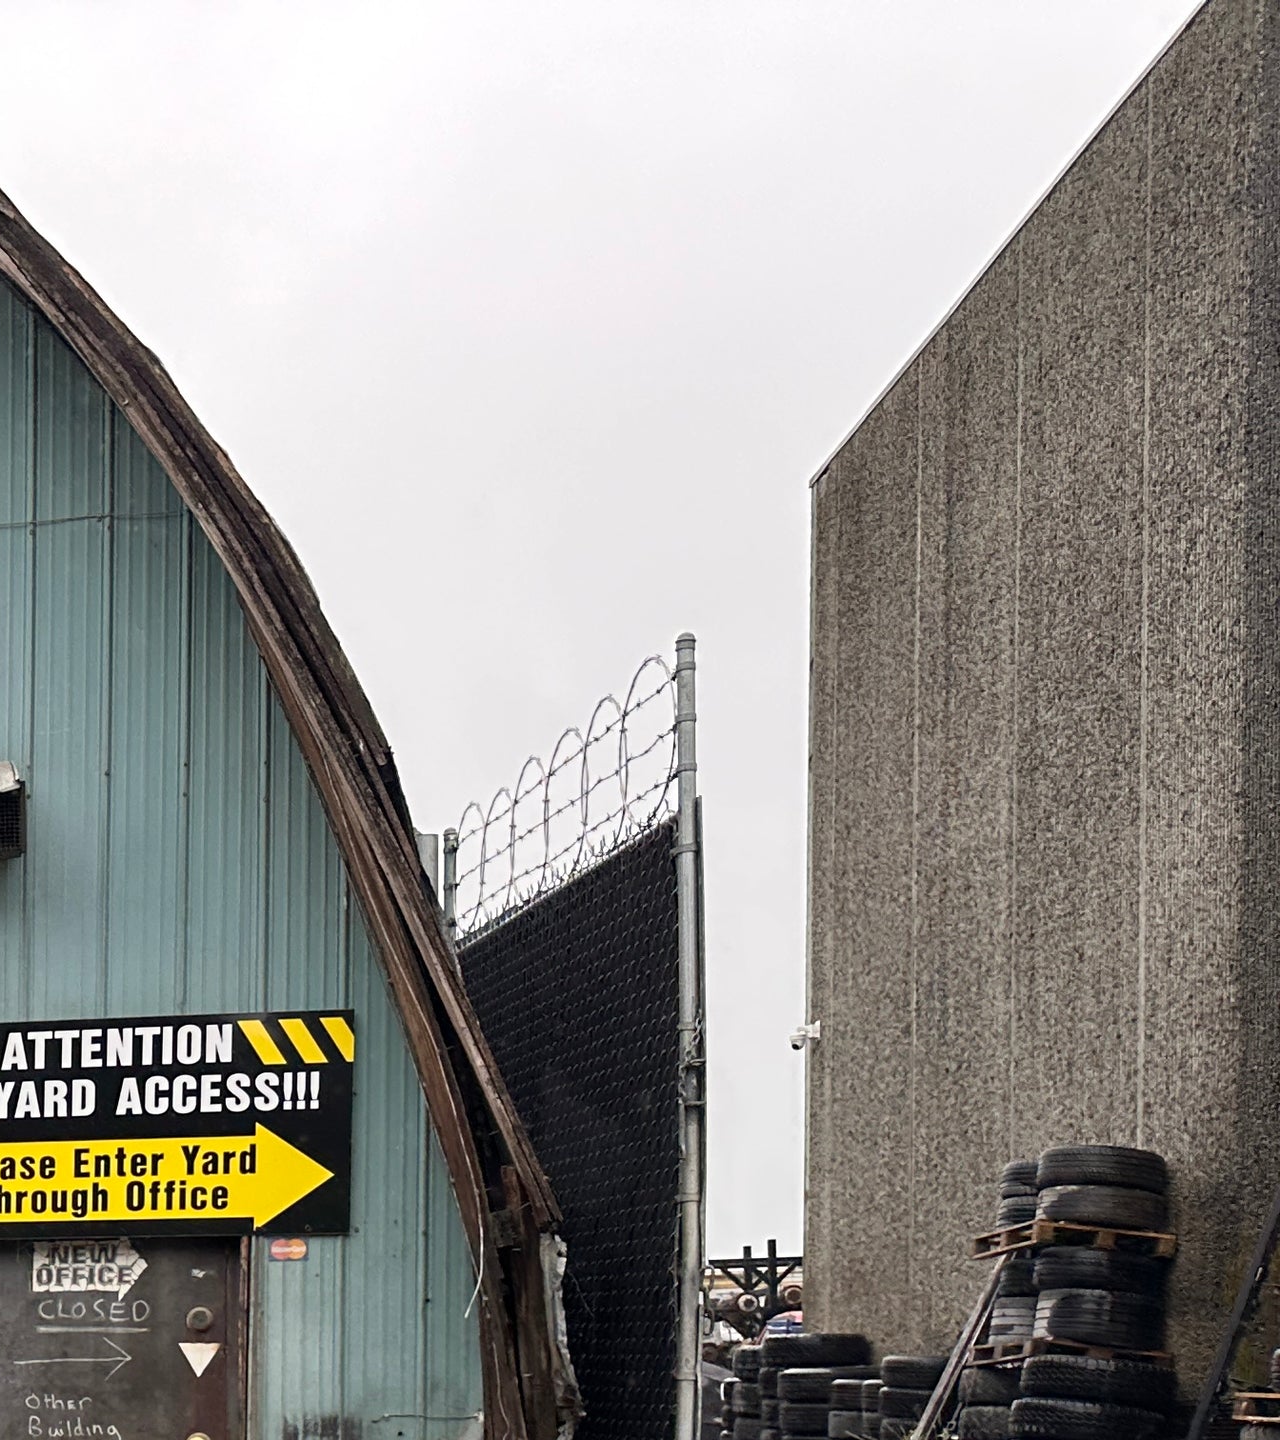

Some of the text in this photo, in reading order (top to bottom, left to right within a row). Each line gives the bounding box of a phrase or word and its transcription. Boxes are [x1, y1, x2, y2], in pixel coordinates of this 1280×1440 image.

[0, 1022, 234, 1072] ATTENTION
[115, 1070, 320, 1117] ACCESS!!!
[73, 1147, 164, 1178] Enter
[181, 1143, 257, 1175] Yard
[126, 1179, 229, 1212] Office
[49, 1243, 116, 1264] NEW
[36, 1264, 133, 1286] OFFICE
[38, 1298, 150, 1322] CLOSED
